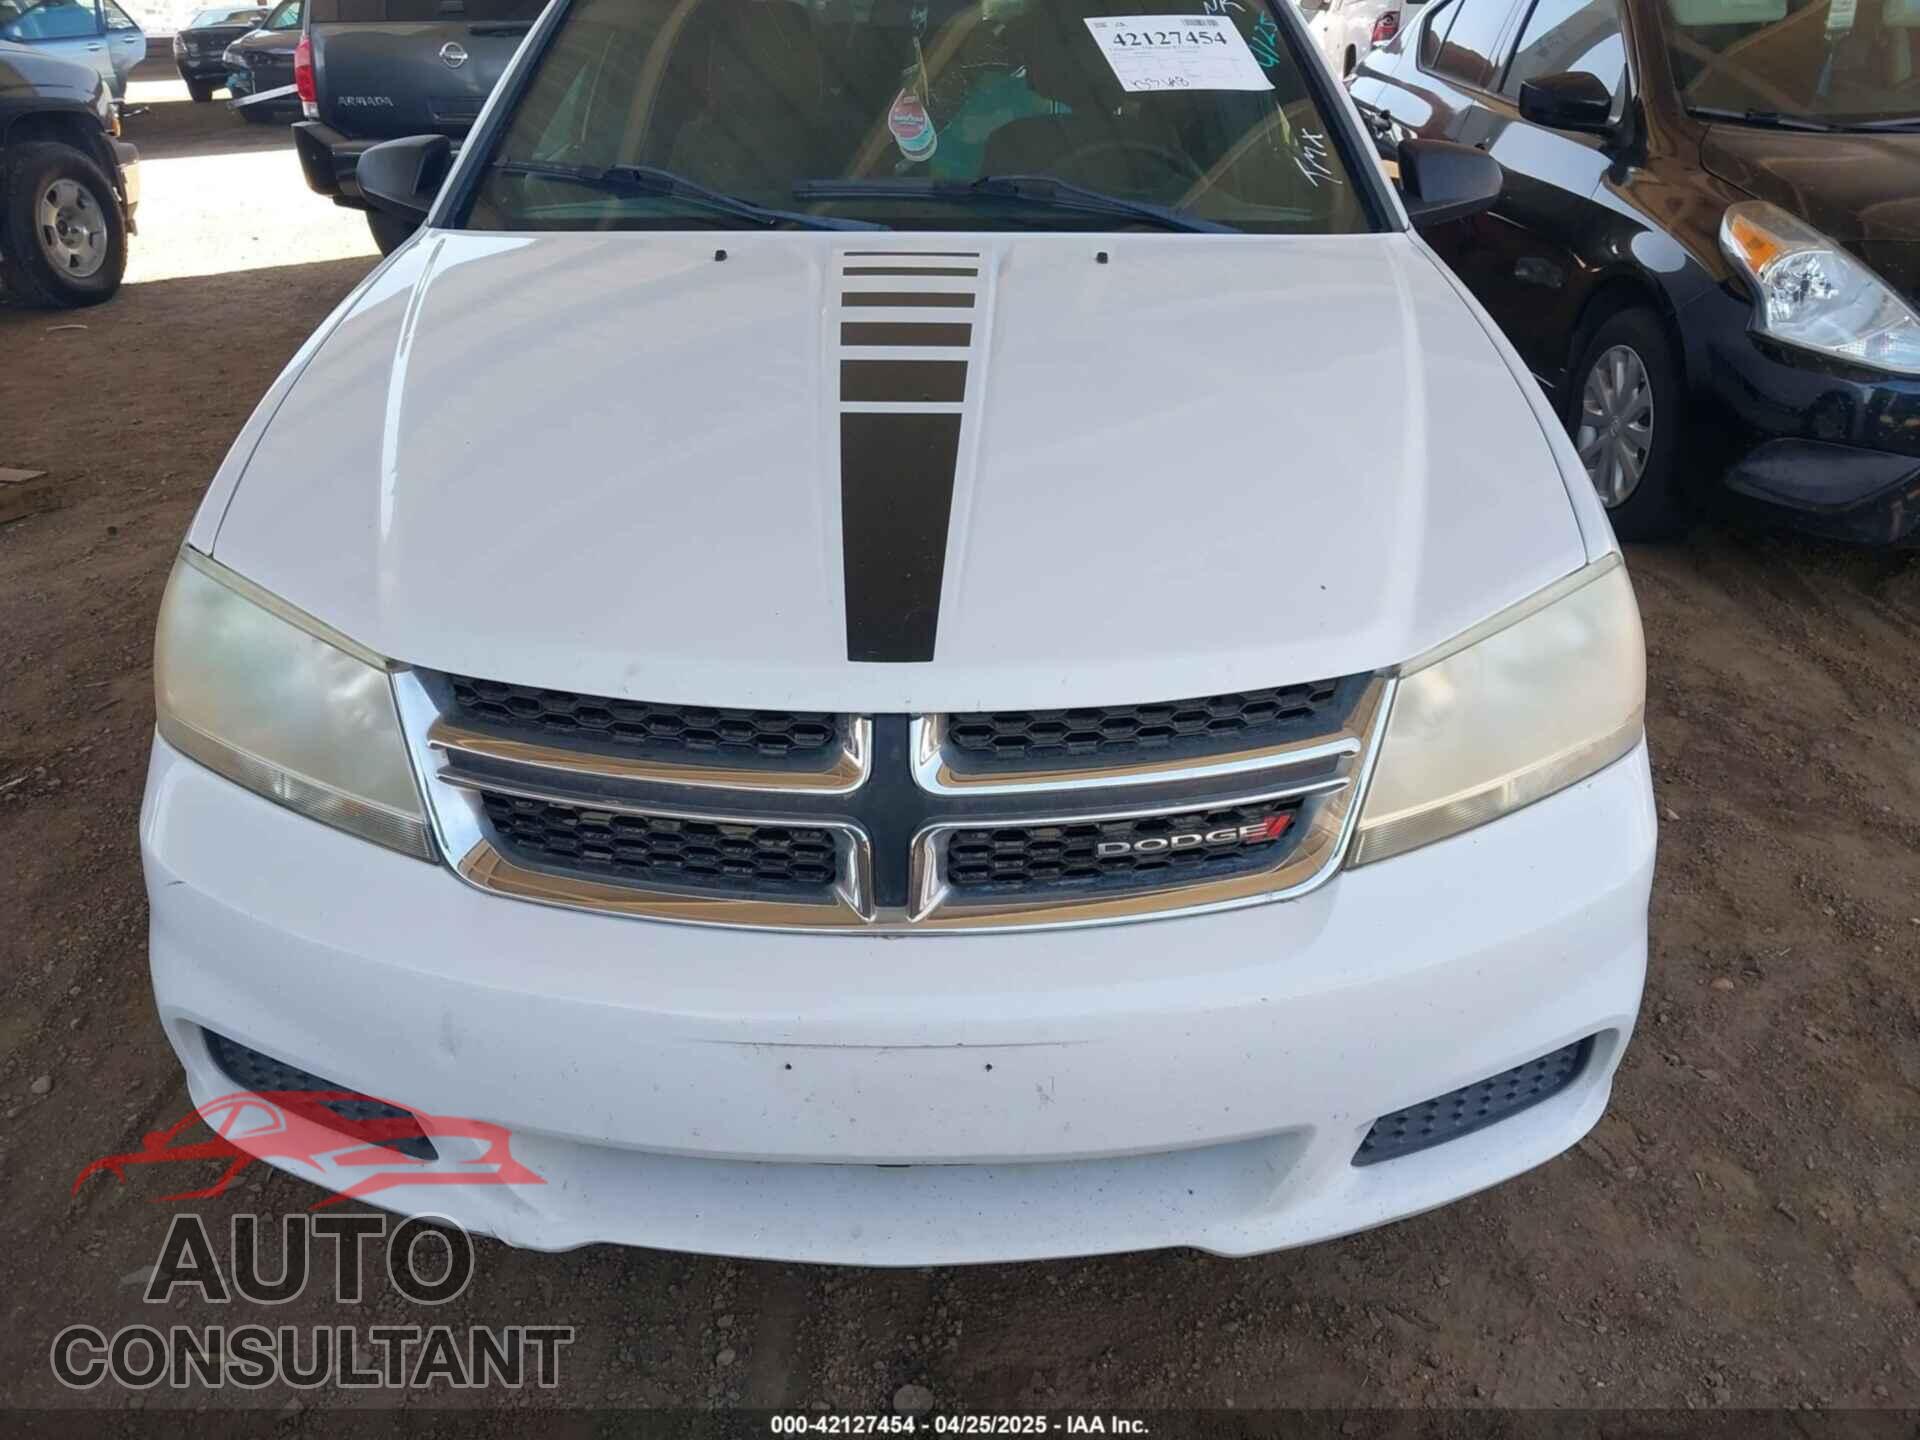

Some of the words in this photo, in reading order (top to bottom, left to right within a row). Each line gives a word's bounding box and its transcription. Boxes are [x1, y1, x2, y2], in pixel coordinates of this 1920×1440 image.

[1112, 31, 1227, 47] 42127454
[338, 96, 394, 107] ARMADA
[1097, 822, 1268, 858] DODGE
